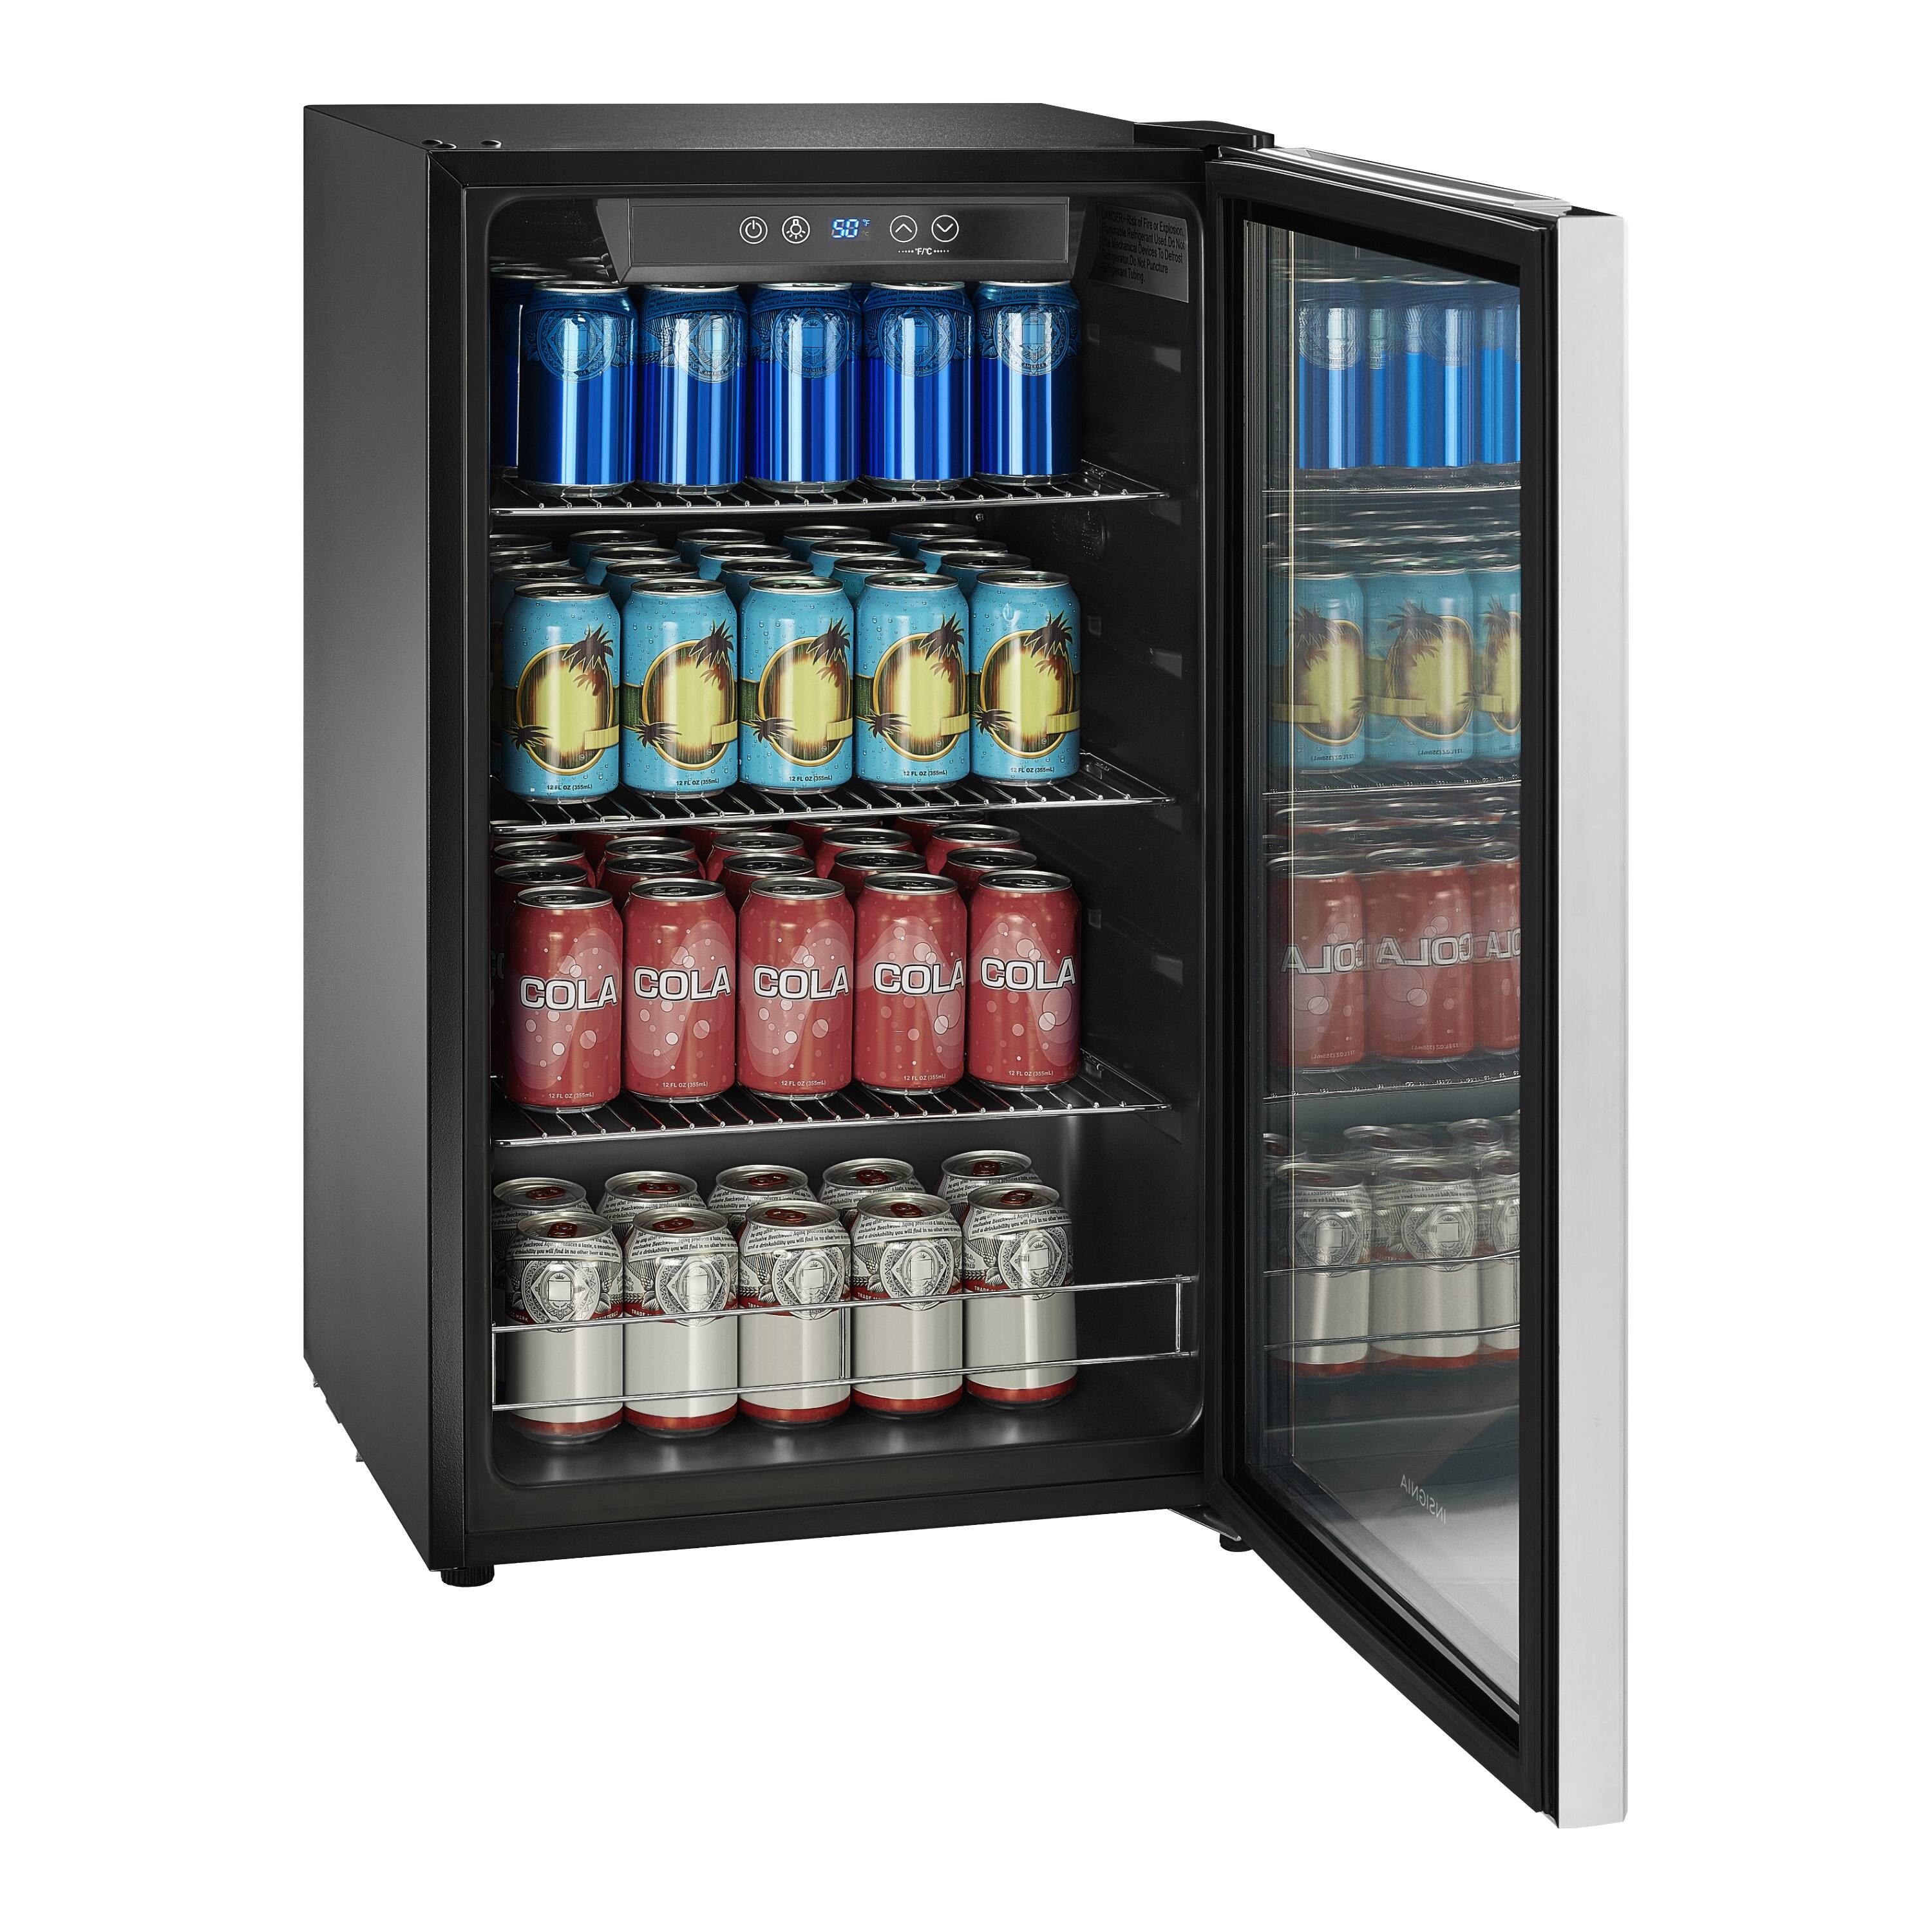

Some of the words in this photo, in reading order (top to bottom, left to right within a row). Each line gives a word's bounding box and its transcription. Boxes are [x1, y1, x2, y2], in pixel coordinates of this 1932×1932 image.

[832, 218, 859, 238] 50
[1127, 228, 1153, 244] Refrigerant
[1176, 238, 1185, 251] Not
[1137, 217, 1142, 226] of
[1143, 218, 1153, 229] Fire
[1153, 223, 1159, 231] or
[1159, 221, 1184, 236] Explosion.
[1112, 237, 1137, 253] Mechanical
[1138, 243, 1157, 258] Devices
[1158, 247, 1164, 260] To
[1164, 249, 1183, 263] Defrost
[1128, 268, 1145, 284] Tubing.
[1137, 258, 1146, 269] Not
[1146, 259, 1168, 274] Puncture
[634, 965, 731, 1003] COLA
[753, 964, 849, 1001] COLA
[873, 958, 965, 996] COLA
[980, 956, 1077, 992] COLA
[519, 975, 618, 1012] COLA
